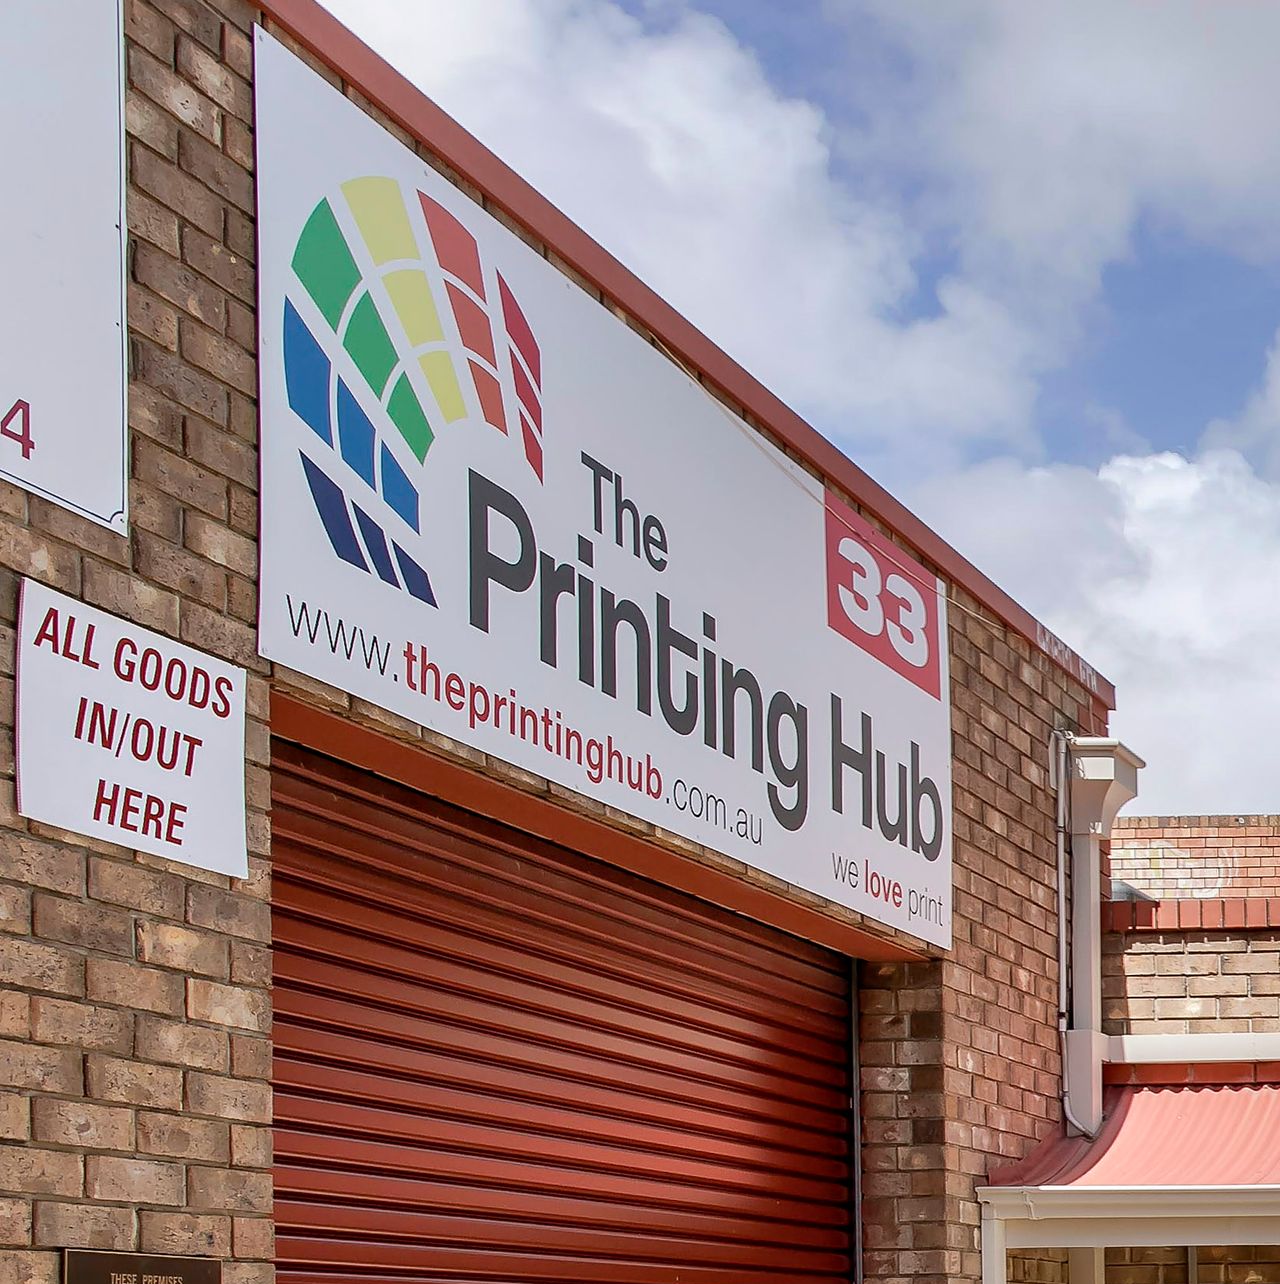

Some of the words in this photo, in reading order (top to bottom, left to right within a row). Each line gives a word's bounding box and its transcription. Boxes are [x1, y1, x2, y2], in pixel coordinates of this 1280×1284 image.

[580, 450, 669, 573] The
[836, 536, 929, 669] 33
[33, 606, 101, 671] ALL
[113, 636, 235, 719] GOODS
[285, 593, 764, 847] www.theprintinghub.com.au
[468, 467, 808, 832] Printing
[830, 691, 943, 863] Hub
[73, 696, 204, 778] IN/OUT
[92, 778, 189, 847] HERE
[832, 850, 860, 889] we
[863, 858, 903, 908] love
[907, 886, 944, 928] print
